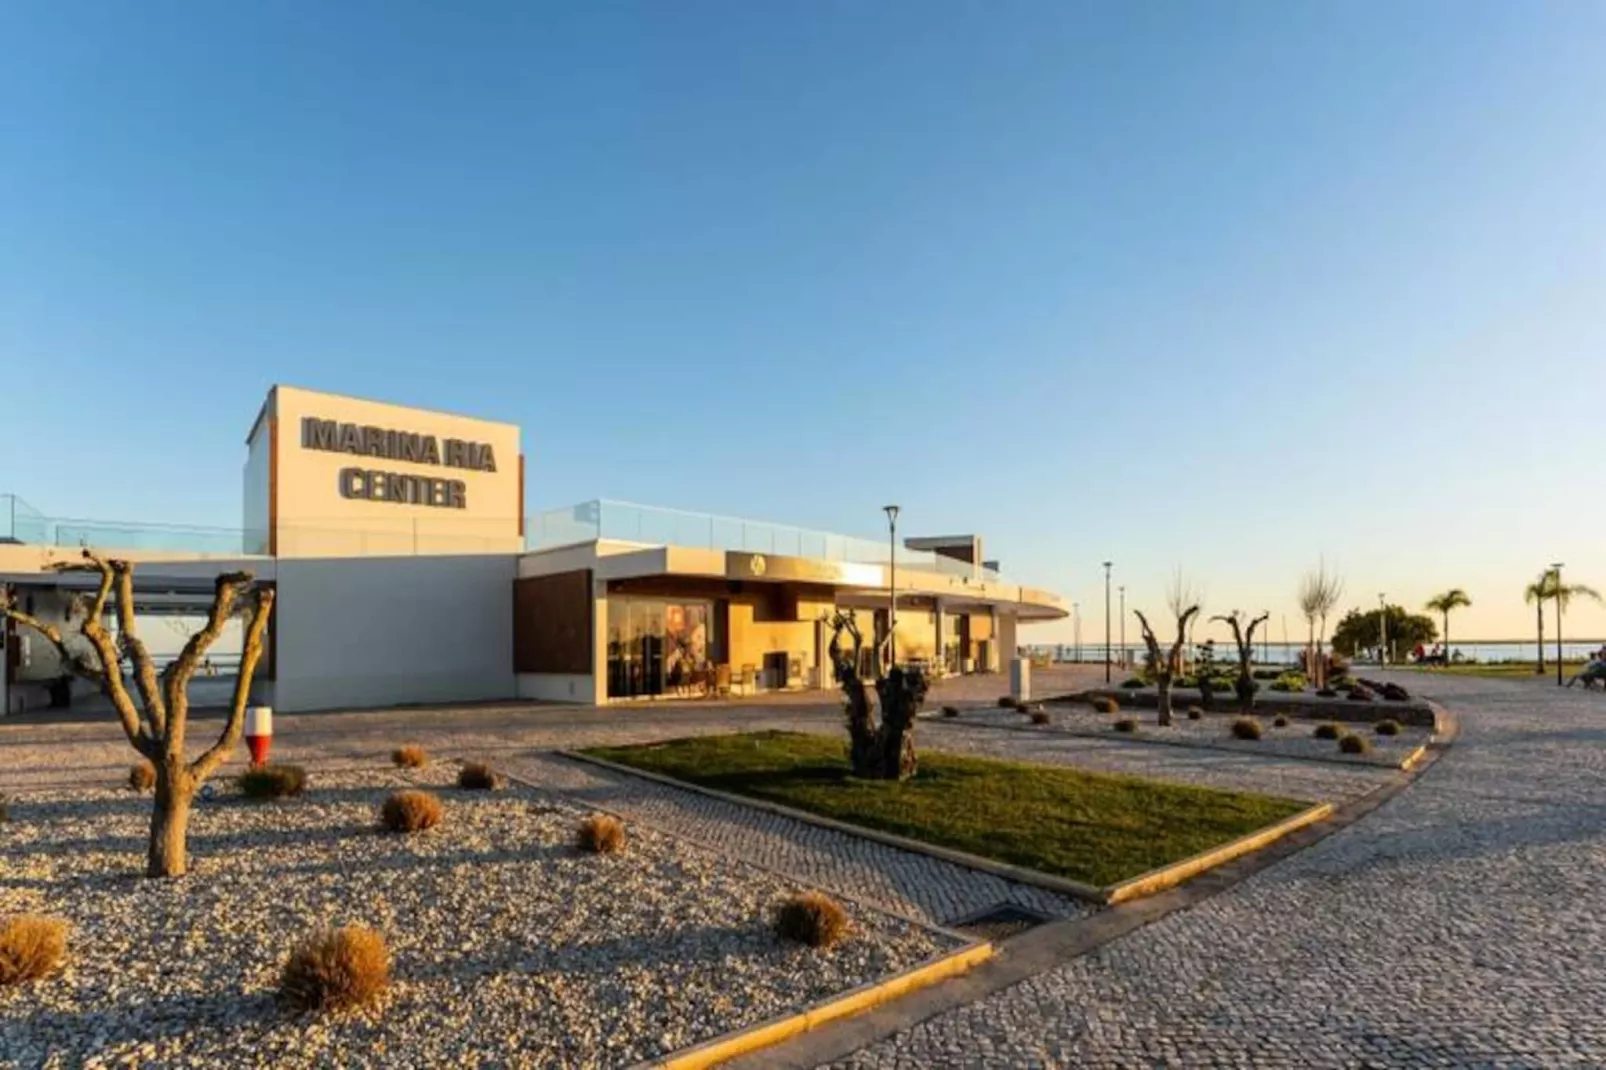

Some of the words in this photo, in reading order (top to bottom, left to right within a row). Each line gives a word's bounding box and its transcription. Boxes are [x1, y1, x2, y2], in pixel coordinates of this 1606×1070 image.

[301, 417, 440, 464] MARINA
[442, 438, 497, 472] RIA
[339, 467, 466, 508] CENTER
